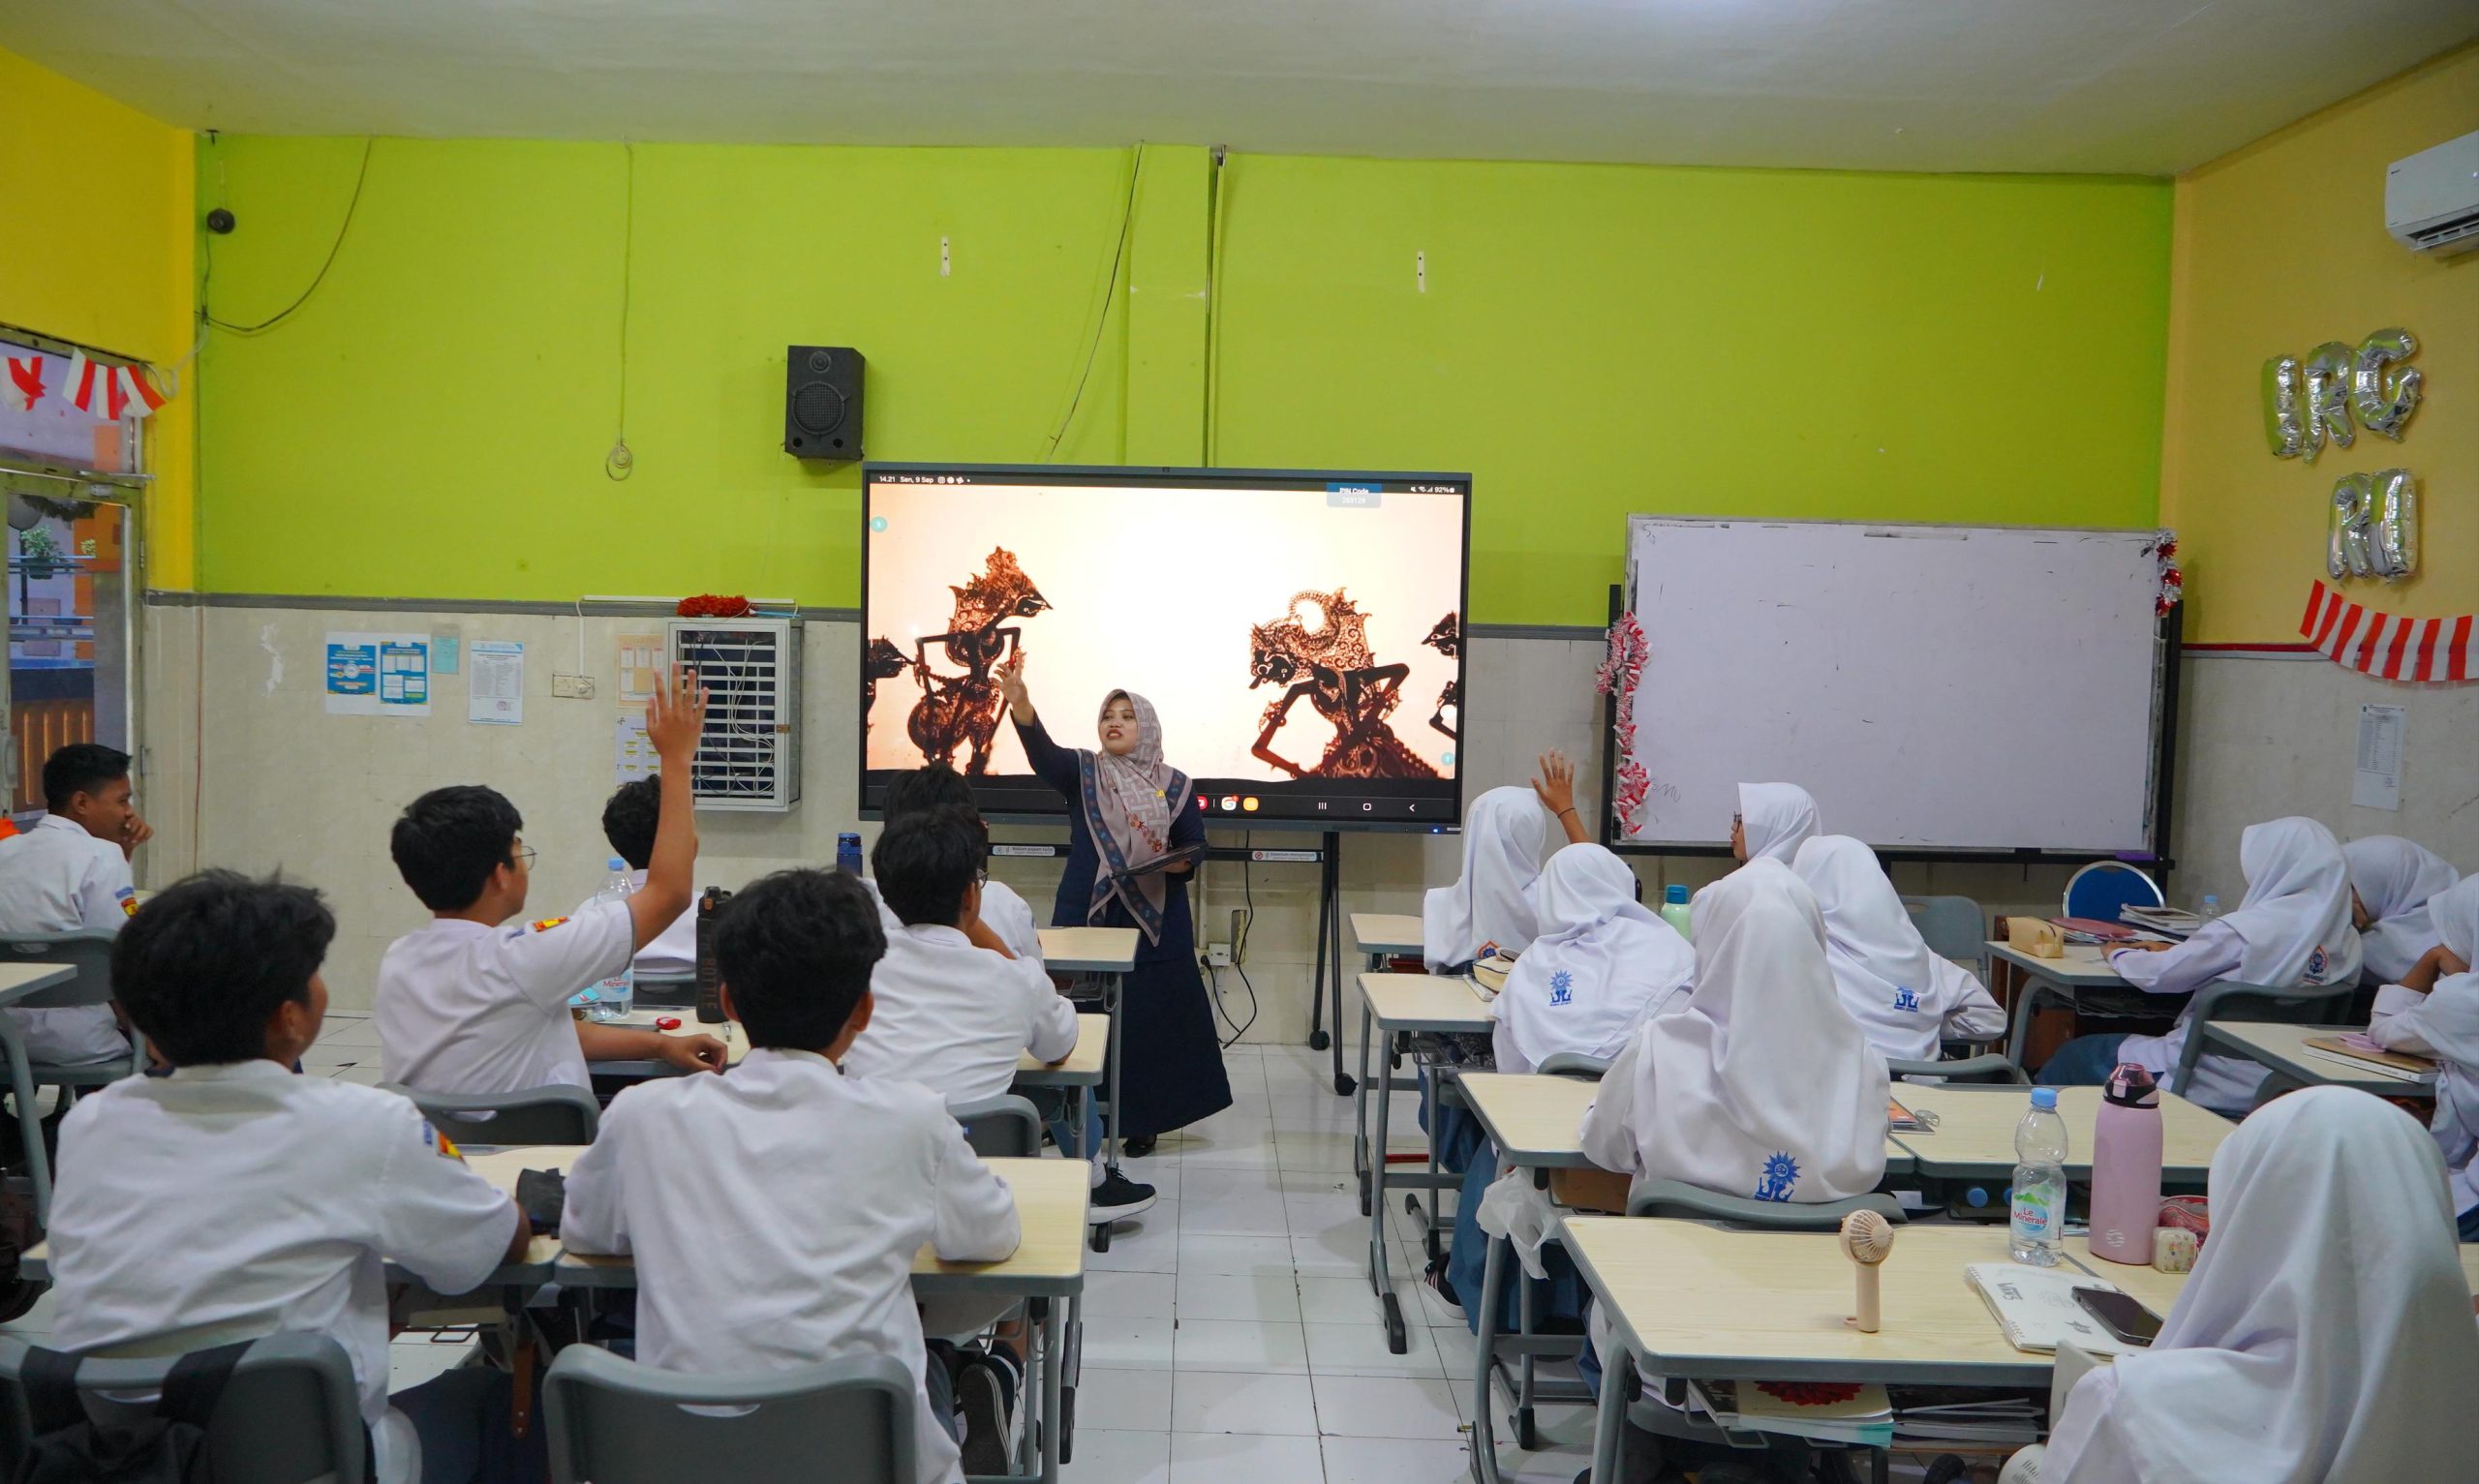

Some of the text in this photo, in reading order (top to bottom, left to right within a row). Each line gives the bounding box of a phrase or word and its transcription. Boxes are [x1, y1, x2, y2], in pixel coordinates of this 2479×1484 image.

[900, 475, 914, 484] Sen,
[2023, 1207, 2034, 1216] Le
[2014, 1210, 2047, 1226] Minerale
